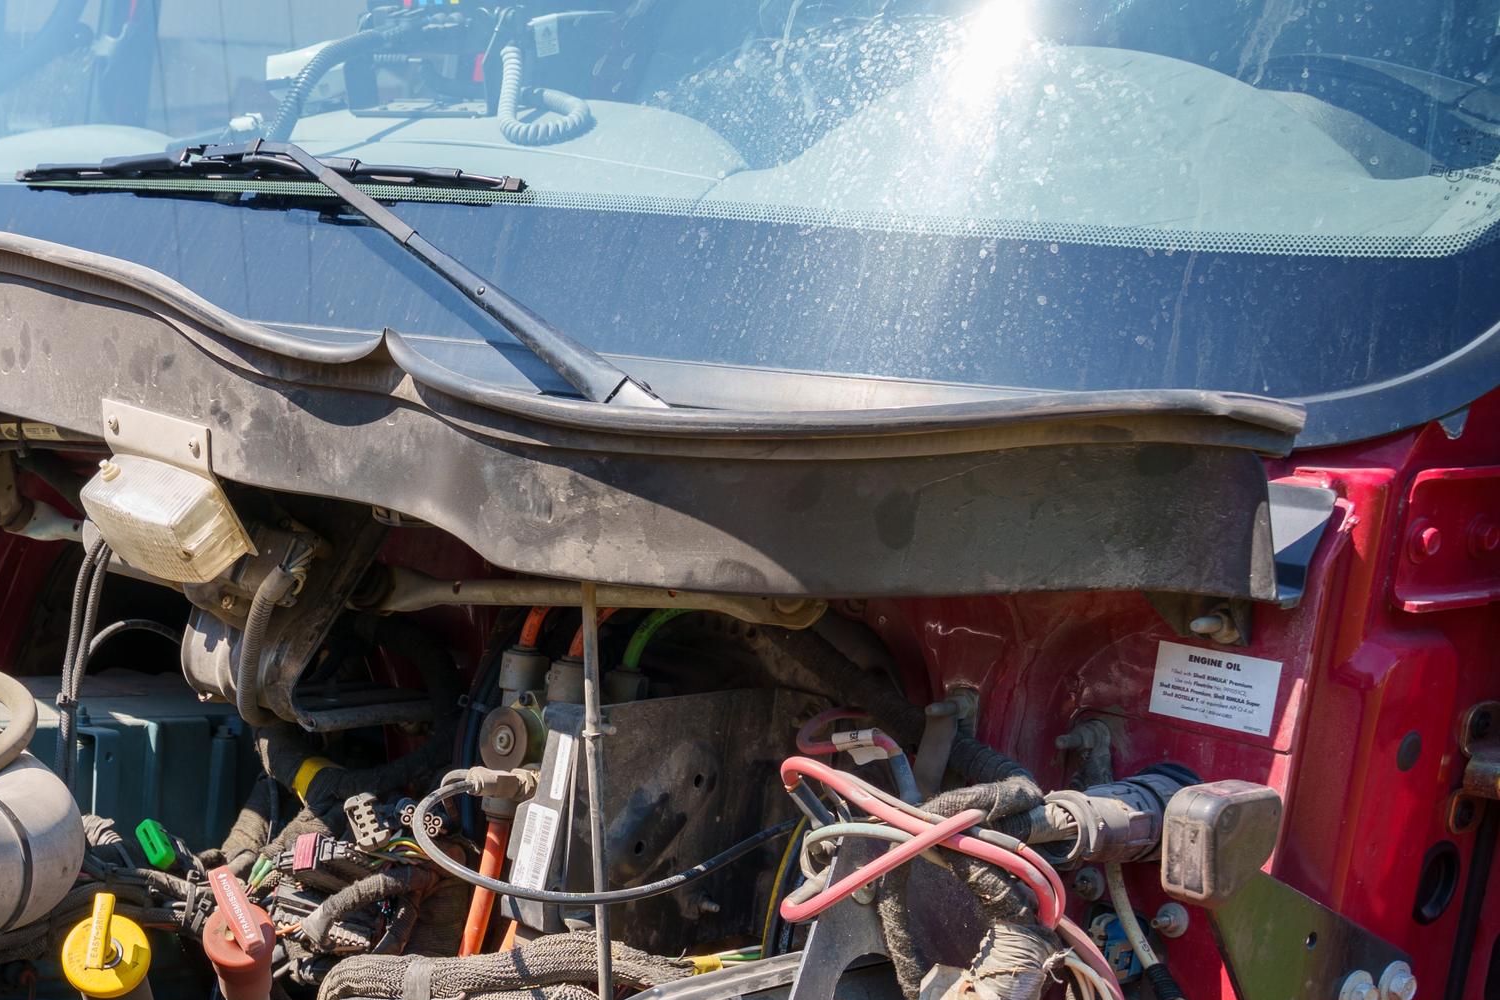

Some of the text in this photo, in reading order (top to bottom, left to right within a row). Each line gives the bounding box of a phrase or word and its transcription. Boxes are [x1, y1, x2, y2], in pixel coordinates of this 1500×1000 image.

[1188, 655, 1241, 671] ENGINE OIL
[220, 878, 251, 935] TRANSMISSION
